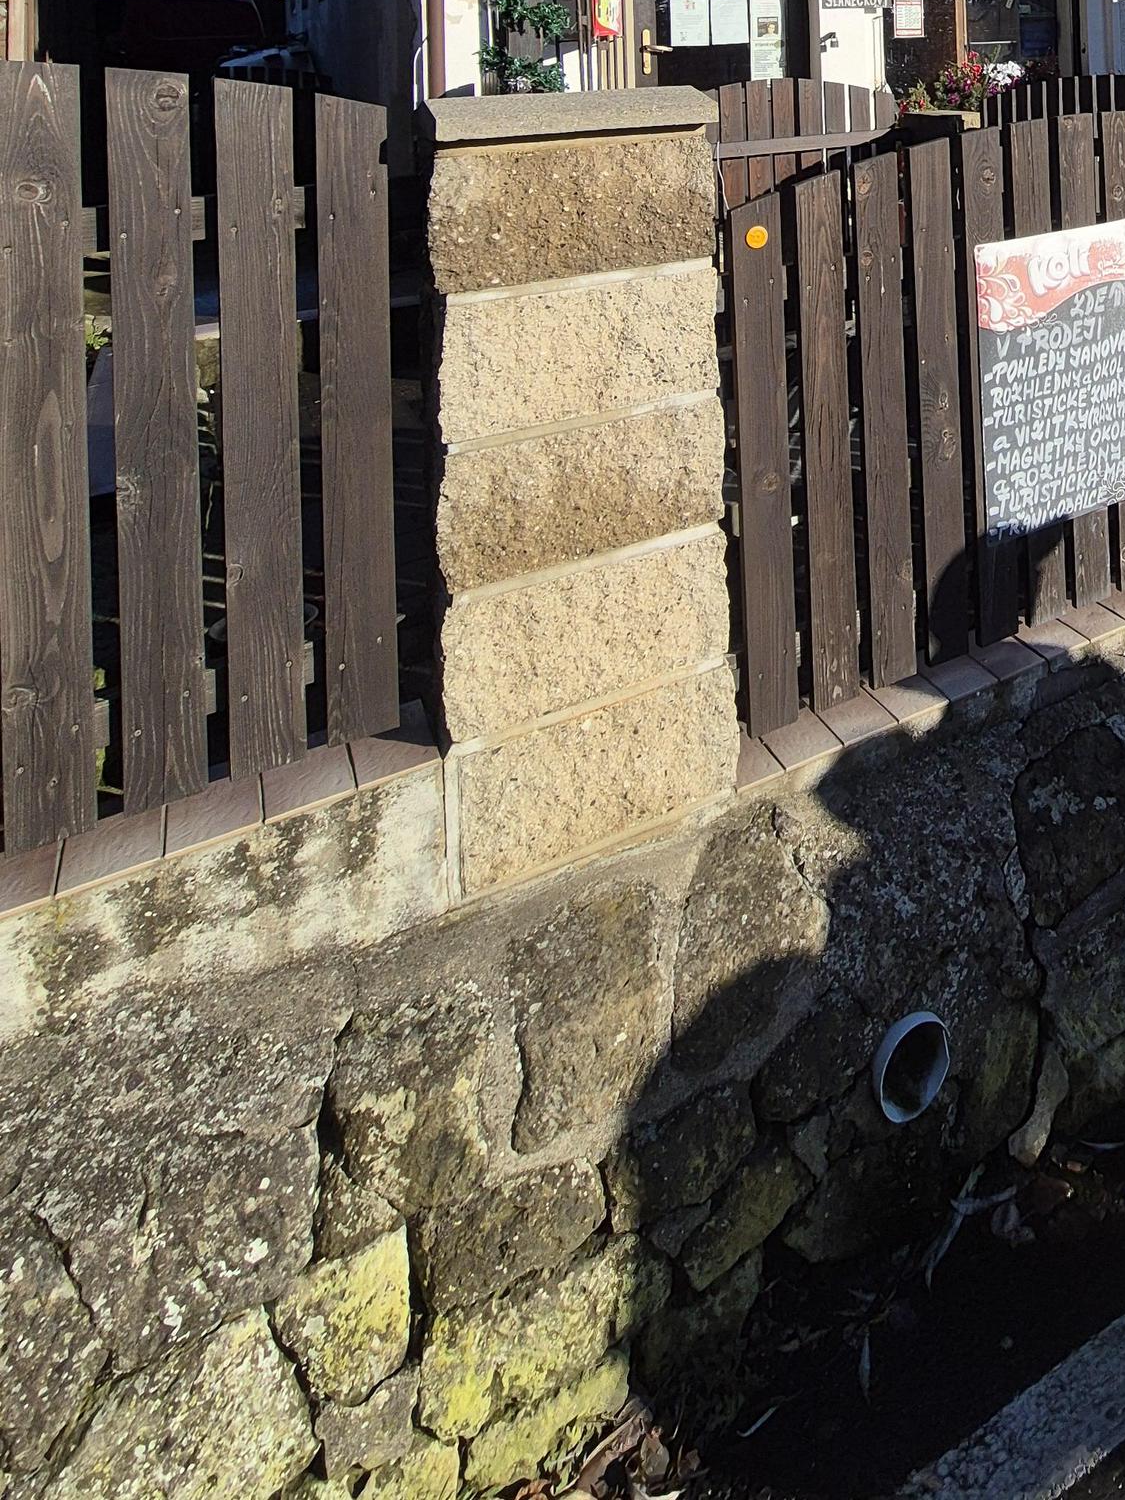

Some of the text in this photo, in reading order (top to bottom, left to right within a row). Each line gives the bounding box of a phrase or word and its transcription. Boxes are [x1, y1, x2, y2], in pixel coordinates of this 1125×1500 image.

[1070, 285, 1108, 317] ZDE
[996, 316, 1102, 359] V PRODEJI
[991, 369, 1083, 408] ROZHLEDNY
[993, 436, 1010, 451] a
[1011, 442, 1121, 489] ROZHLEDNY
